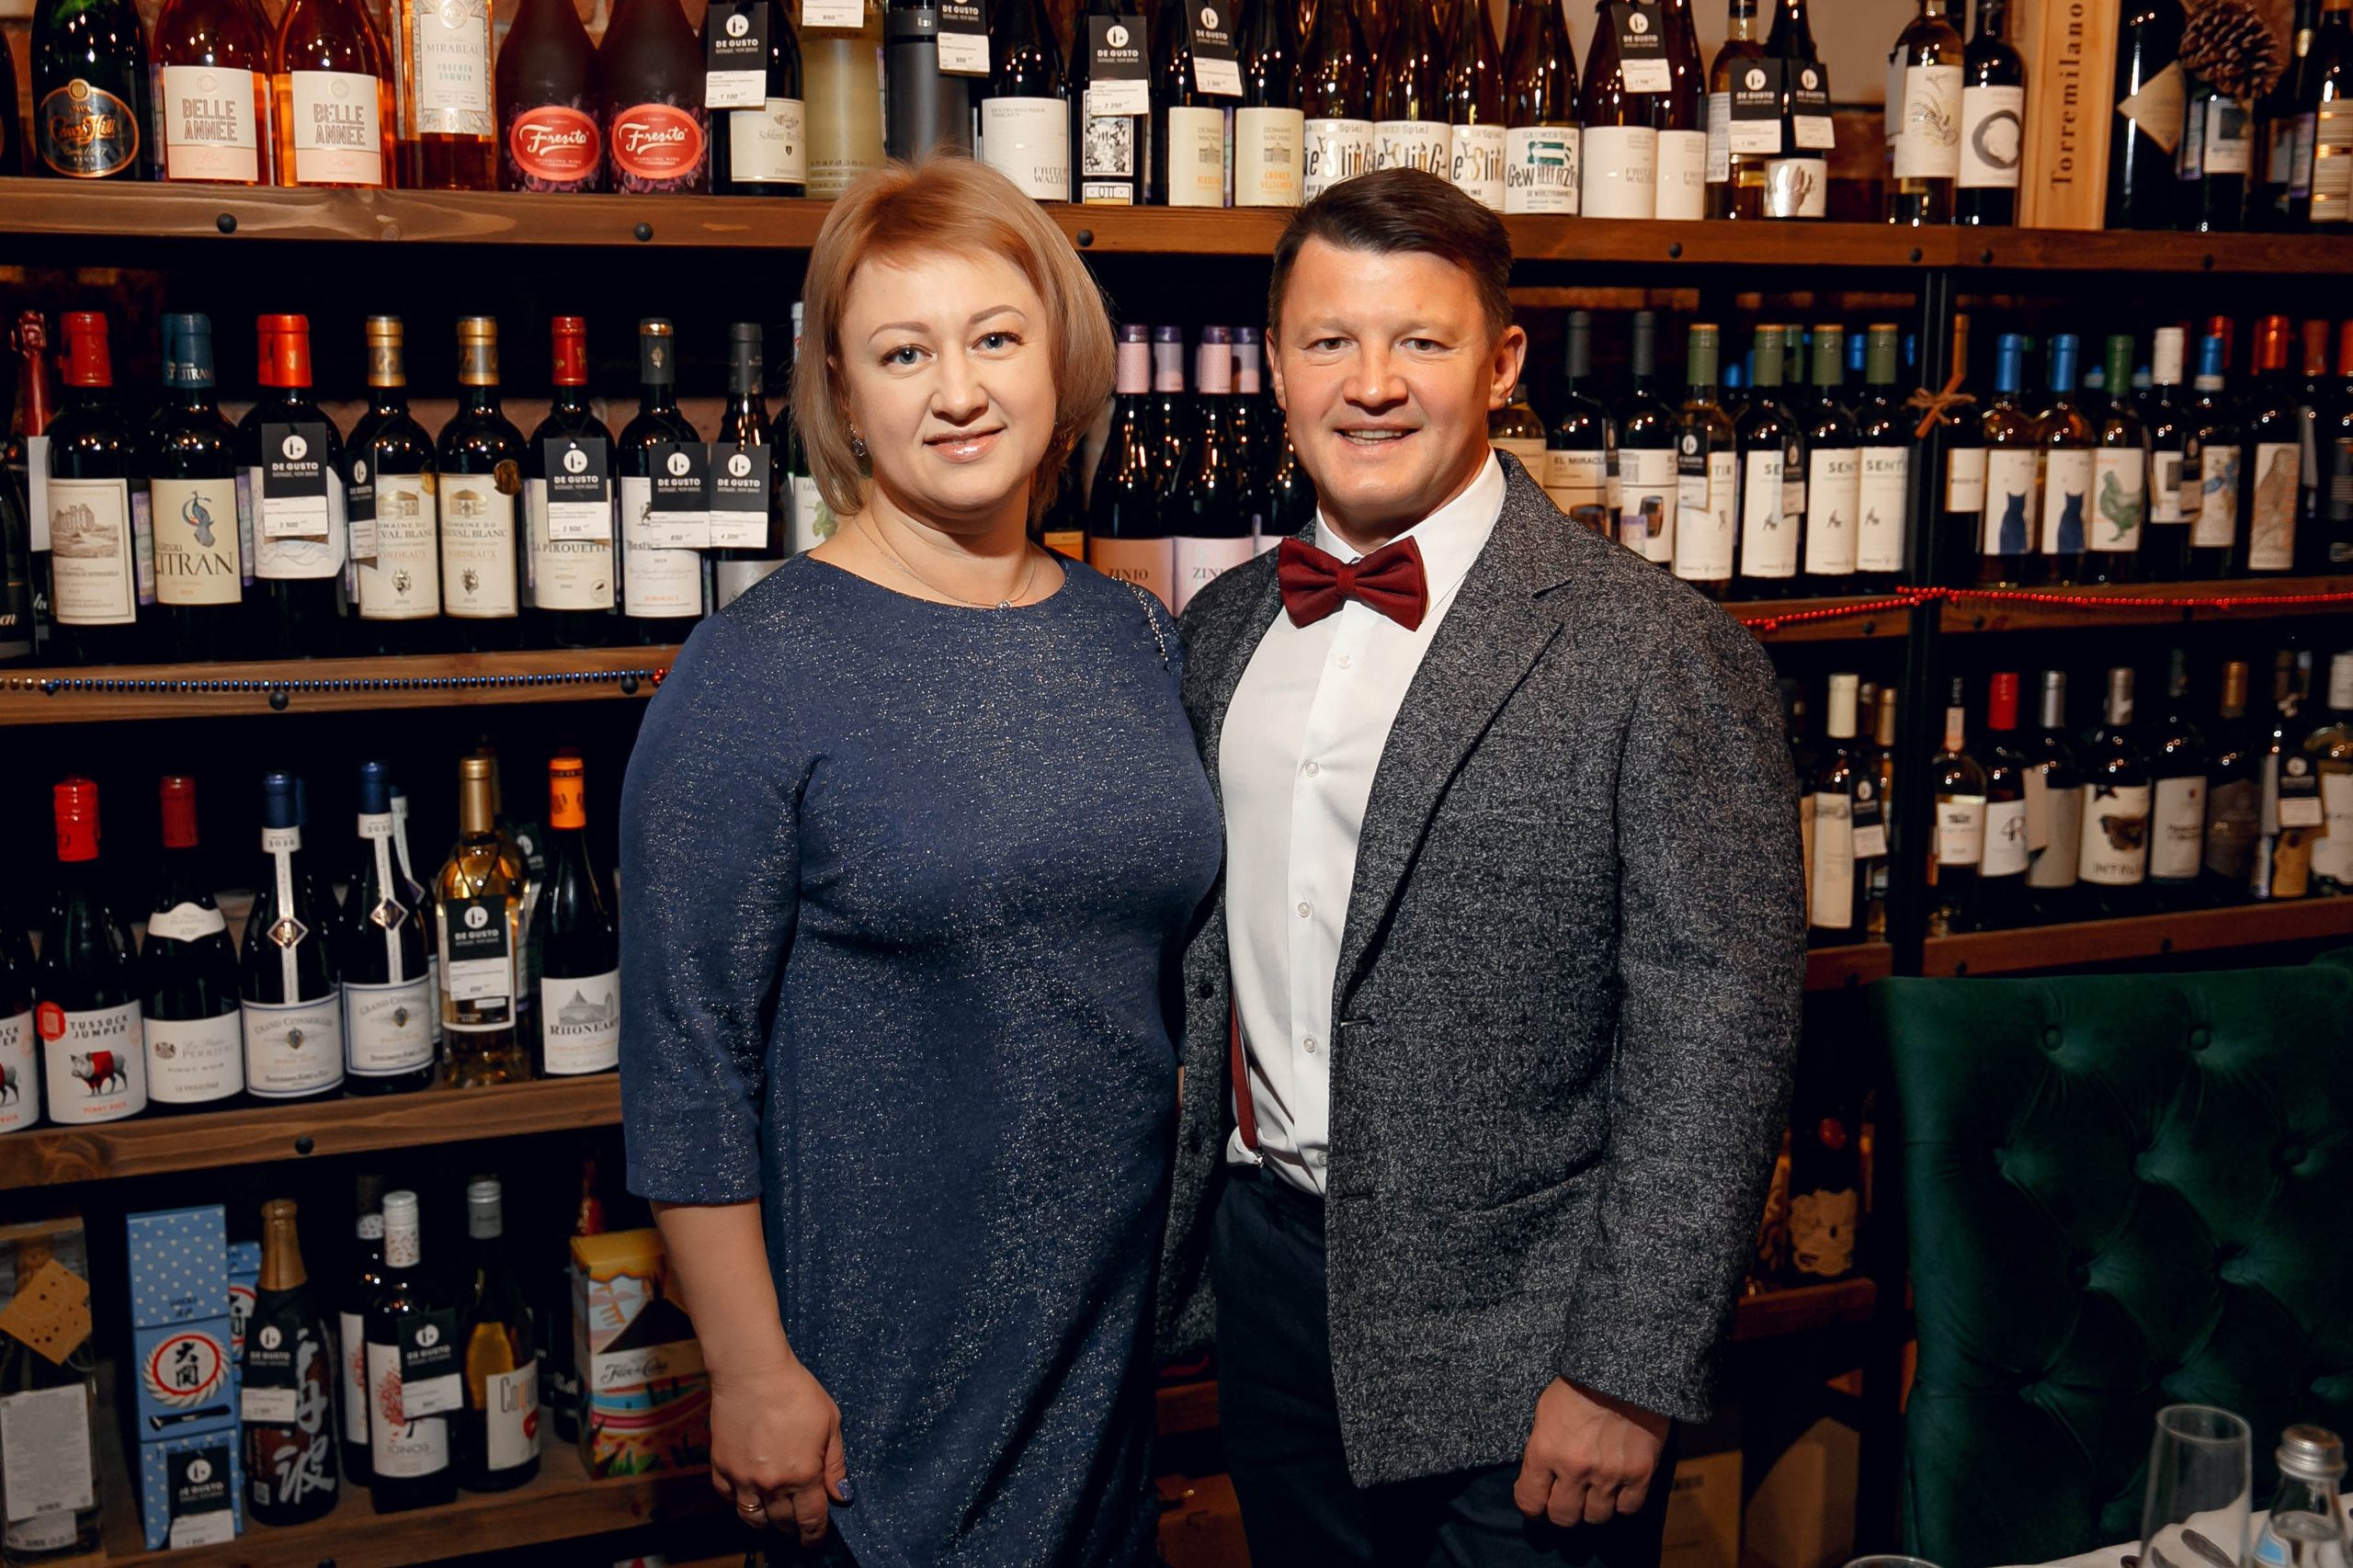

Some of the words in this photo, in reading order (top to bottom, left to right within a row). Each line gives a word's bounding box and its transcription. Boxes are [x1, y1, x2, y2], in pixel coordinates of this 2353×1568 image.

[942, 5, 953, 13] DE
[953, 6, 979, 15] GUSTO
[1196, 29, 1206, 38] DE
[1206, 31, 1228, 40] GUSTO
[426, 42, 483, 55] MIRABEAU
[729, 39, 758, 47] GUSTO
[2050, 4, 2084, 190] Torremilano
[182, 98, 236, 120] BELLE
[313, 103, 365, 125] BELLE
[184, 119, 238, 142] ANNEE
[315, 124, 366, 146] ANNEE
[519, 123, 587, 153] Fresita
[619, 122, 687, 153] Fresita
[272, 462, 284, 471] DE
[286, 461, 319, 471] GUSTO
[553, 475, 566, 483] DE
[567, 475, 599, 483] GUSTO
[671, 478, 701, 486] GUSTO
[731, 479, 760, 487] GUSTO
[472, 529, 508, 538] BLANC
[455, 932, 467, 940] DE
[468, 929, 499, 939] GUSTO
[70, 1014, 128, 1030] TUSSOCK
[74, 1024, 127, 1040] JUMPER
